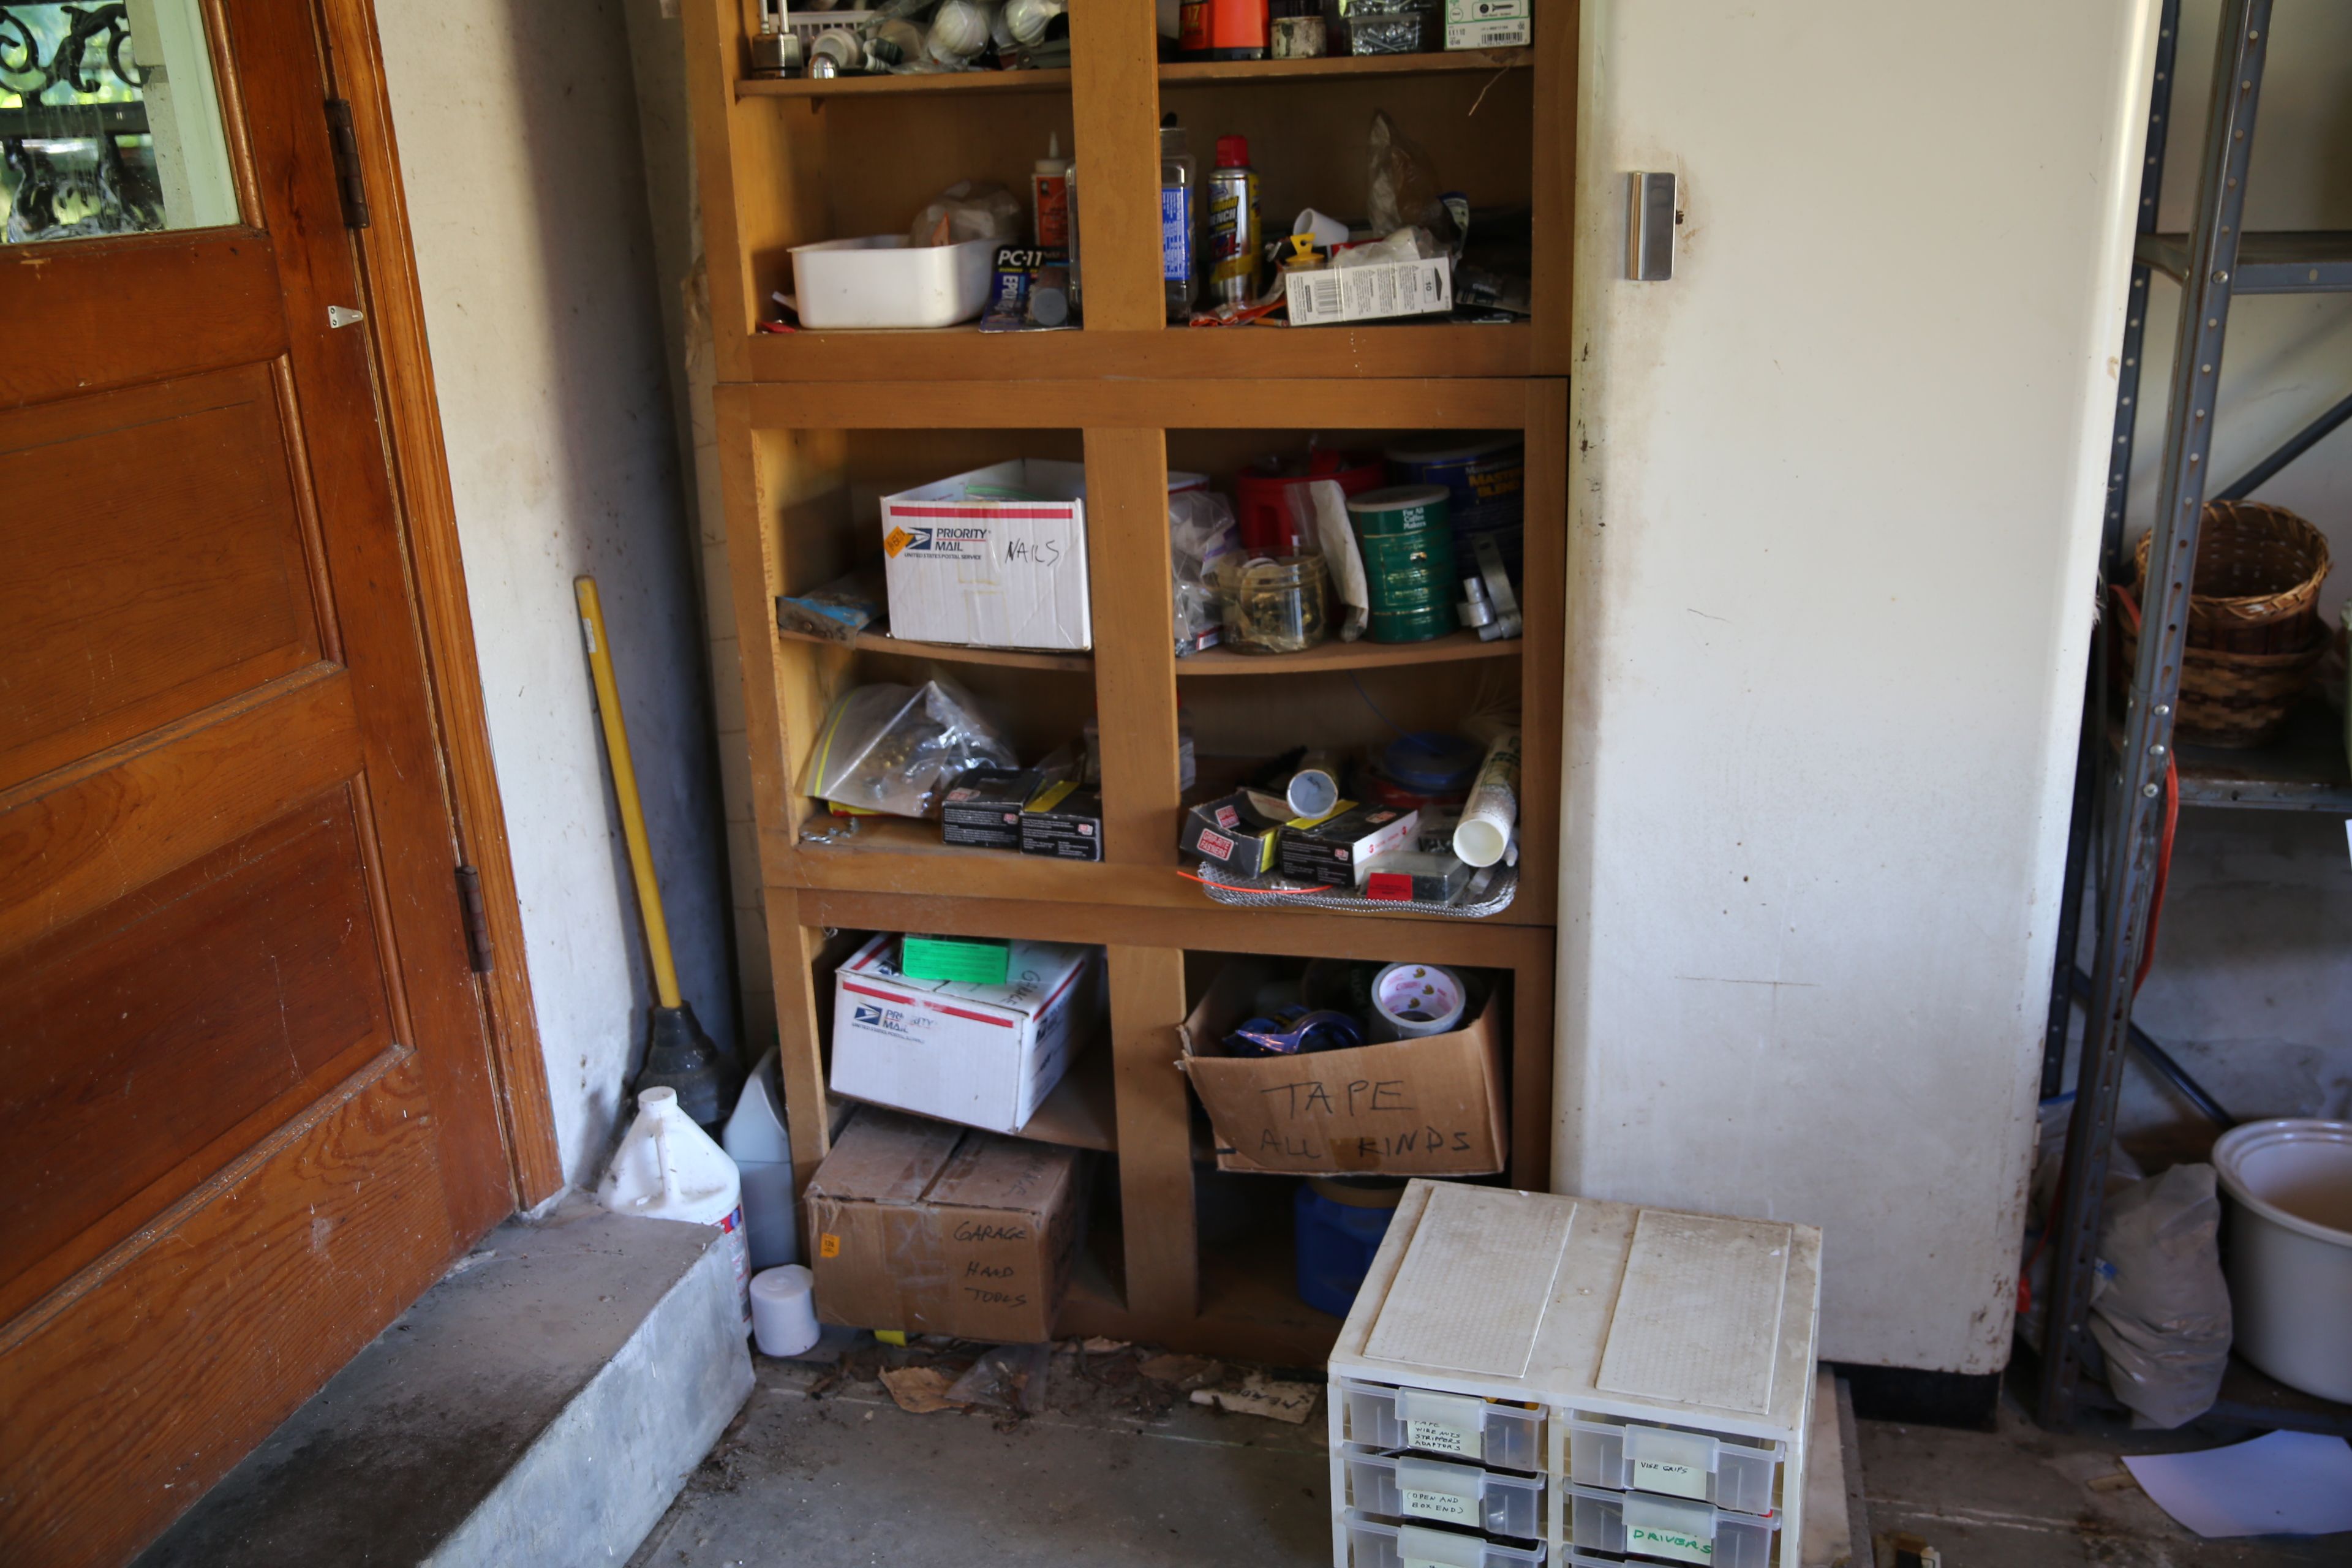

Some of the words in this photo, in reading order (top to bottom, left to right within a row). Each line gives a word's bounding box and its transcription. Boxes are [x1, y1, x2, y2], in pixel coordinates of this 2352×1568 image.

[936, 528, 987, 538] PRIORITY
[1403, 521, 1427, 530] Makers
[935, 541, 963, 552] MAIL
[1005, 537, 1060, 567] NAILS
[885, 1008, 935, 1027] PRIITY
[1260, 1080, 1415, 1120] TAPE
[1260, 1128, 1323, 1159] ALL
[1357, 1125, 1471, 1158] KINDS
[953, 1220, 1027, 1242] GARAGE
[964, 1260, 1015, 1280] HAND
[963, 1287, 1027, 1308] TOOLS
[1414, 1433, 1461, 1444] STRIPPERS
[1414, 1439, 1461, 1451] ADAPTORS
[1662, 1465, 1688, 1474] GRIPS
[1406, 1491, 1436, 1501] (OPEN
[1435, 1504, 1464, 1514] END)
[1633, 1529, 1713, 1555] DRIVERS
